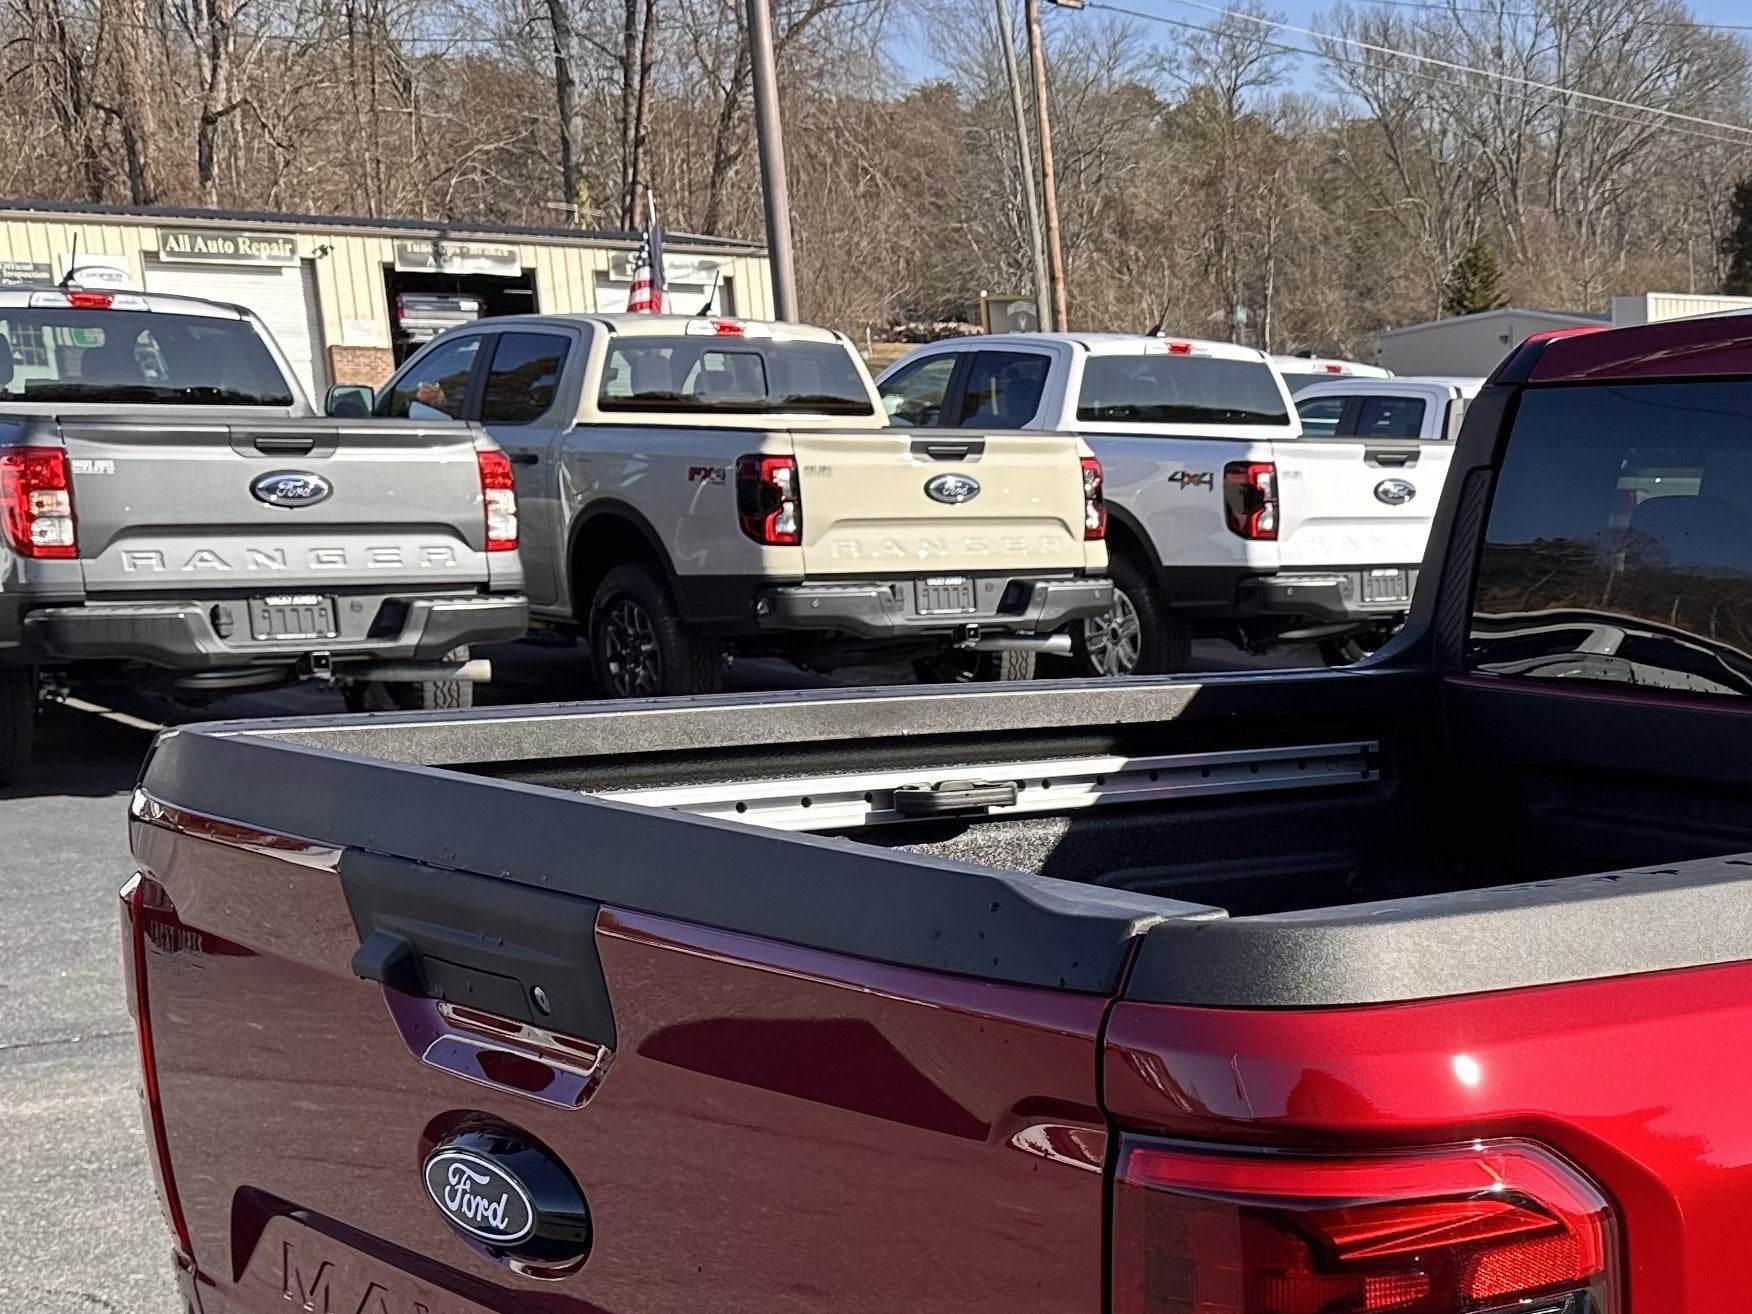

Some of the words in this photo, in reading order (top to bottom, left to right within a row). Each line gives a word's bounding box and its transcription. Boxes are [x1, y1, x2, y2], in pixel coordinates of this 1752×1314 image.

[165, 234, 191, 252] All
[194, 235, 234, 254] Auto
[237, 236, 292, 259] Repair
[688, 465, 726, 481] FX4
[1168, 470, 1214, 492] 4x4
[121, 546, 458, 572] RANGER
[444, 1162, 509, 1230] Ford
